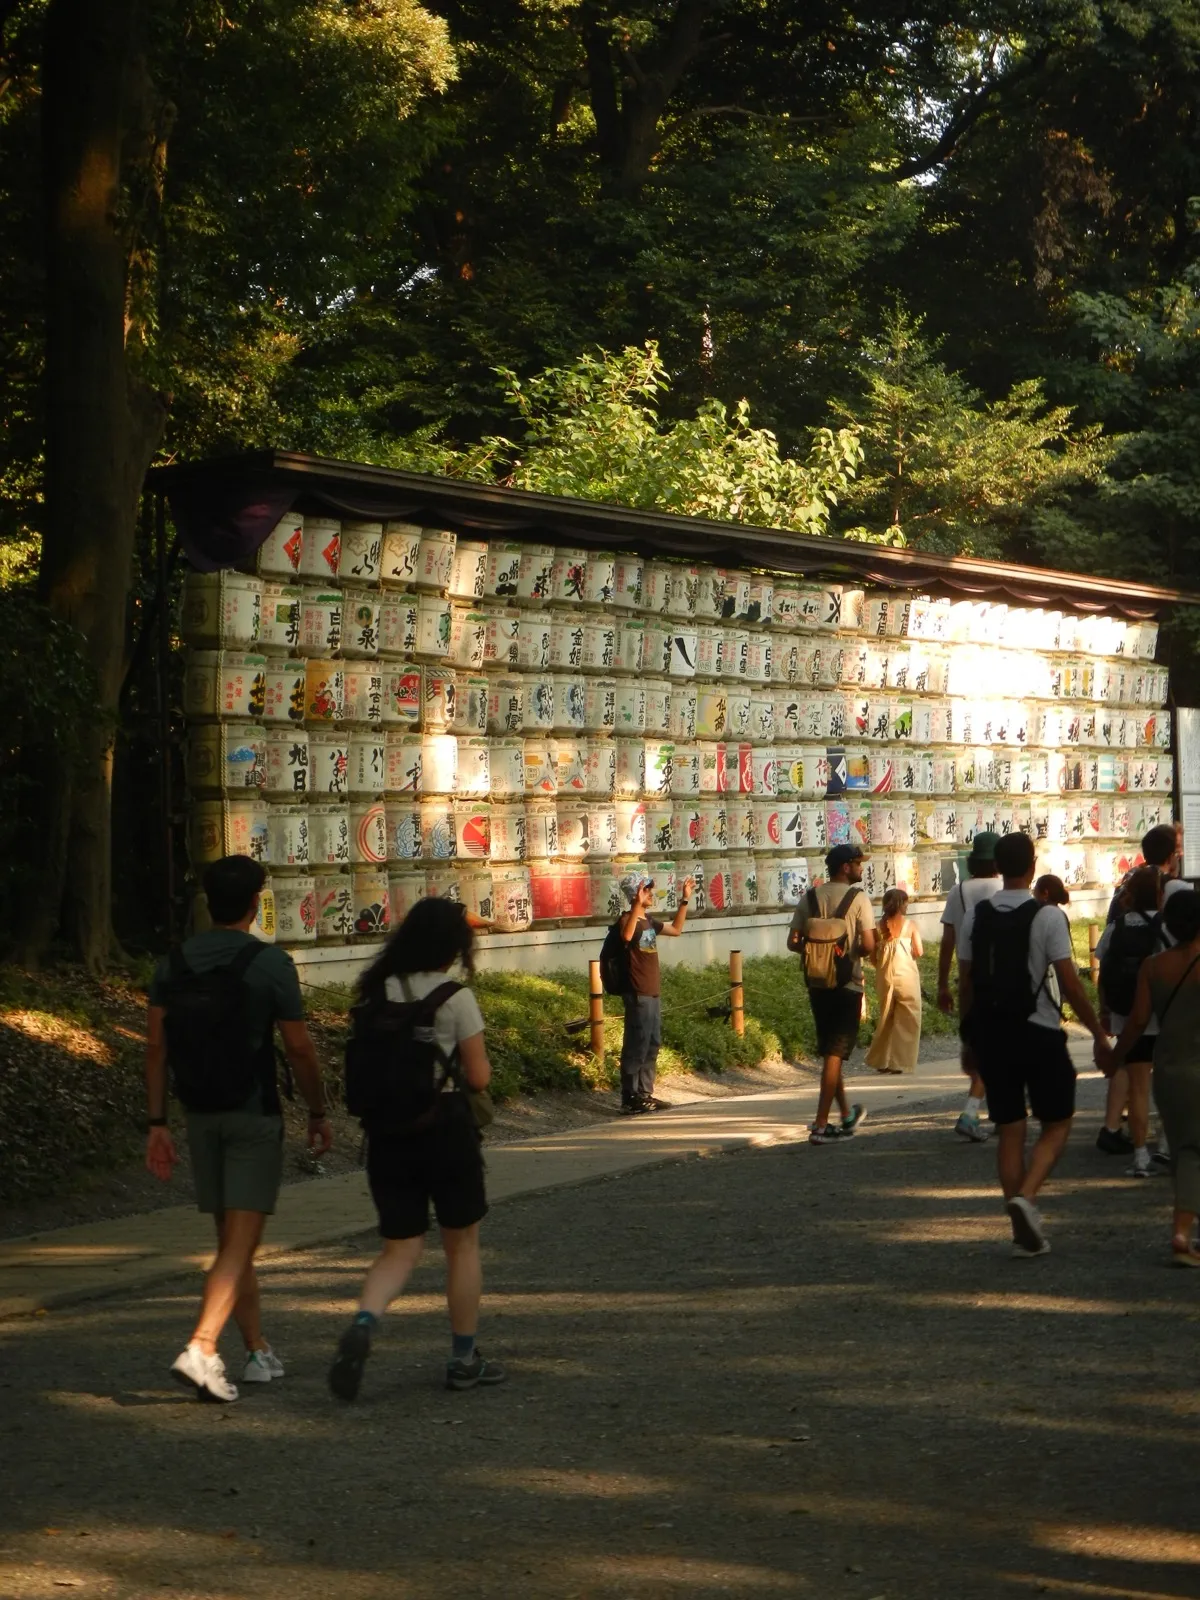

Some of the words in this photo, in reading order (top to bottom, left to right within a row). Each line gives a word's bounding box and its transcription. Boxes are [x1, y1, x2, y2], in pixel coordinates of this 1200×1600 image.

[367, 677, 382, 721] 腰古井
[288, 743, 309, 792] 旭日
